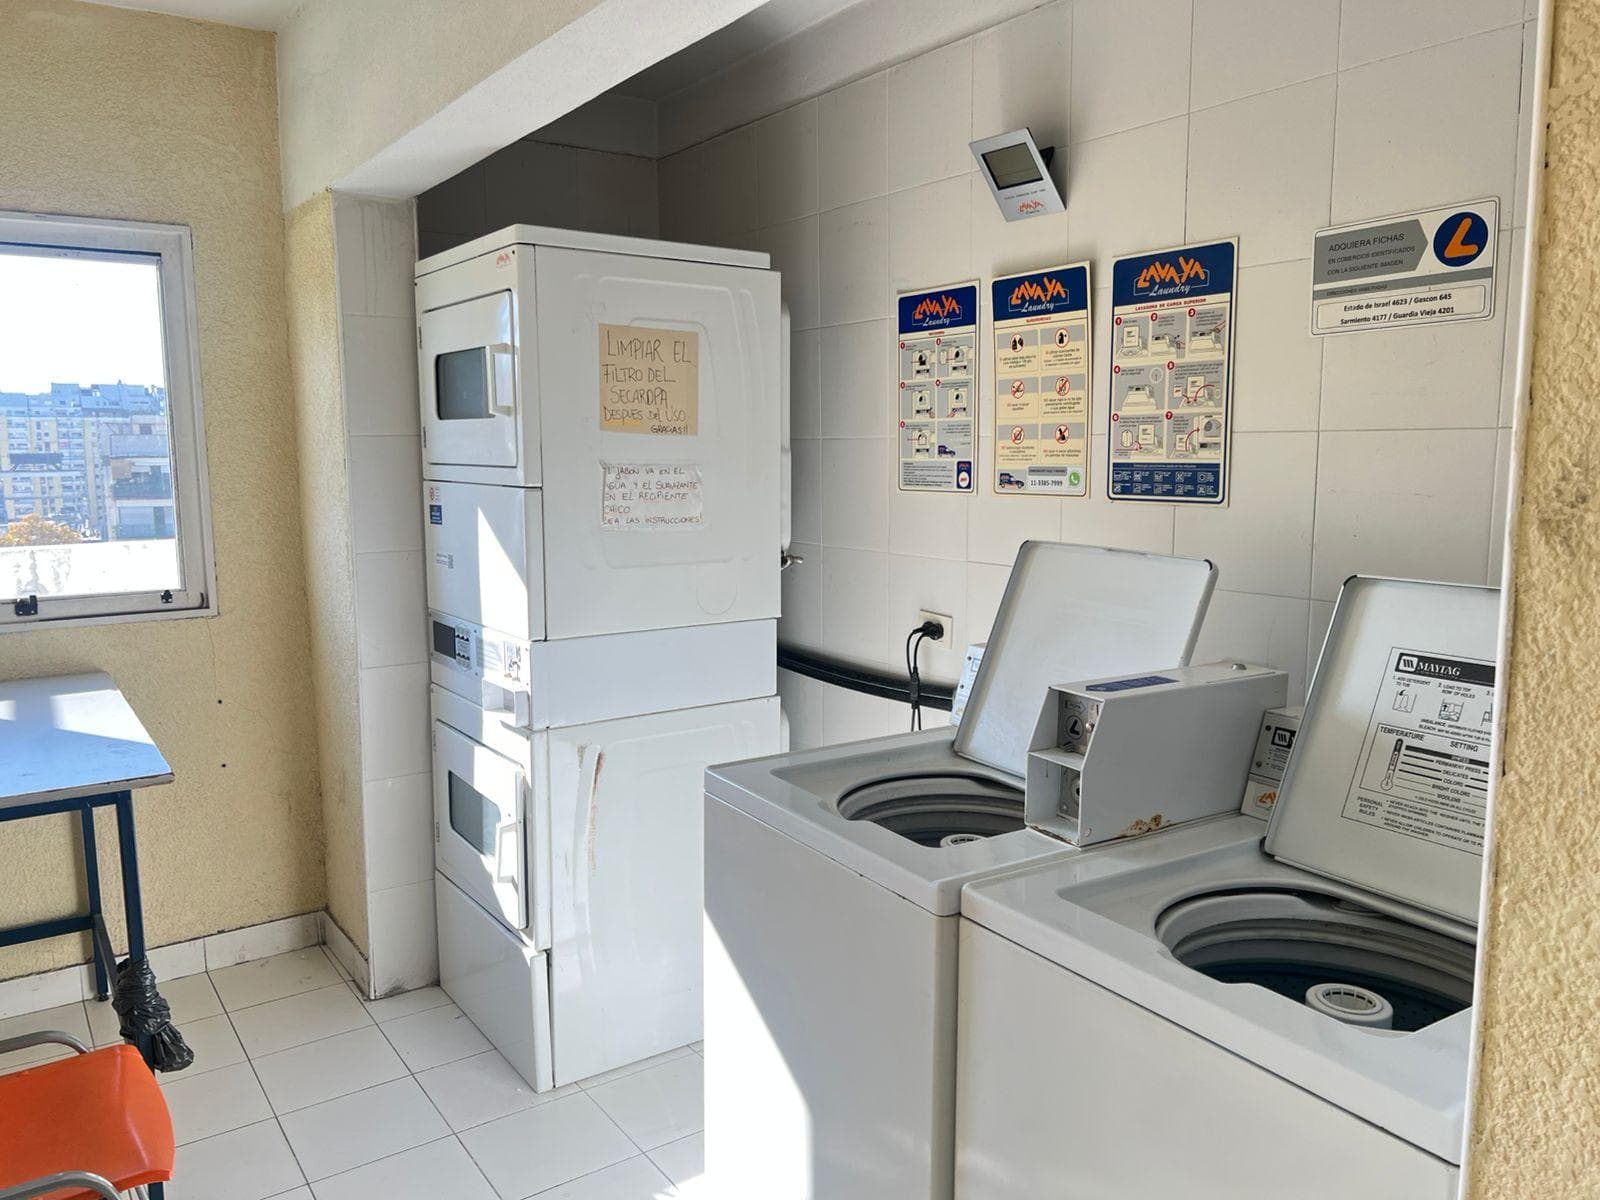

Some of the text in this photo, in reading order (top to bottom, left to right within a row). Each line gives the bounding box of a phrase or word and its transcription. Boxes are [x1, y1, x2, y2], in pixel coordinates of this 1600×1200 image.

[1328, 233, 1405, 252] ADQUIERA FICHAS
[1337, 252, 1370, 263] COMERCIOS
[1371, 246, 1415, 257] IDENTIFICADOS
[1137, 256, 1206, 288] LAVAYA
[1327, 268, 1339, 276] CON
[1348, 263, 1379, 273] SIGUIENTE
[1380, 259, 1403, 267] IMAGEN
[1011, 277, 1066, 305] LAVAYA
[1149, 283, 1190, 296] Laundry
[913, 294, 960, 320] LAVAYA
[1021, 301, 1054, 313] Laundry
[1135, 303, 1158, 311] LAVADORA
[1183, 298, 1206, 306] SUPERIOR
[1343, 303, 1364, 312] Estado
[1365, 302, 1372, 310] de
[1373, 299, 1390, 308] Israel
[1392, 299, 1407, 307] 4623
[1414, 295, 1438, 304] Gascon
[1439, 293, 1452, 301] 645
[1340, 315, 1370, 325] Sarmiento
[1372, 314, 1387, 322] 4177
[1393, 310, 1418, 320] Guardia
[1419, 307, 1437, 318] Vieja
[1438, 306, 1454, 315] 4201
[923, 317, 950, 328] Laundry
[607, 330, 691, 363] LIMPIAR EL
[602, 363, 676, 384] FILTRO DEL
[610, 386, 668, 409] SECAROPA
[665, 406, 686, 422] USO
[645, 467, 654, 475] VA
[659, 467, 670, 475] EN
[673, 467, 685, 475] EL
[642, 480, 652, 490] EL
[622, 491, 634, 501] EL
[604, 505, 631, 514] CHICO
[1417, 662, 1461, 676] MAYTAG
[1406, 678, 1431, 686] DETERGENT
[1460, 691, 1475, 699] HOLES
[1379, 726, 1426, 742] TEMPERATURE
[1450, 740, 1479, 752] SETTING
[1435, 760, 1481, 774] PERMANENT PRESS
[1442, 770, 1469, 779] DELICATES
[1443, 778, 1463, 787] COLORS
[1431, 784, 1470, 797] BRIGHT COLORS
[1357, 796, 1382, 807] PERSONAL
[1437, 794, 1461, 803] WOOLENS
[1359, 809, 1375, 817] RULES
[1360, 803, 1378, 811] SAFETY
[1413, 826, 1435, 834] CHILDREN
[1442, 832, 1462, 842] OPERATE
[1434, 823, 1460, 833] CONTAINING
